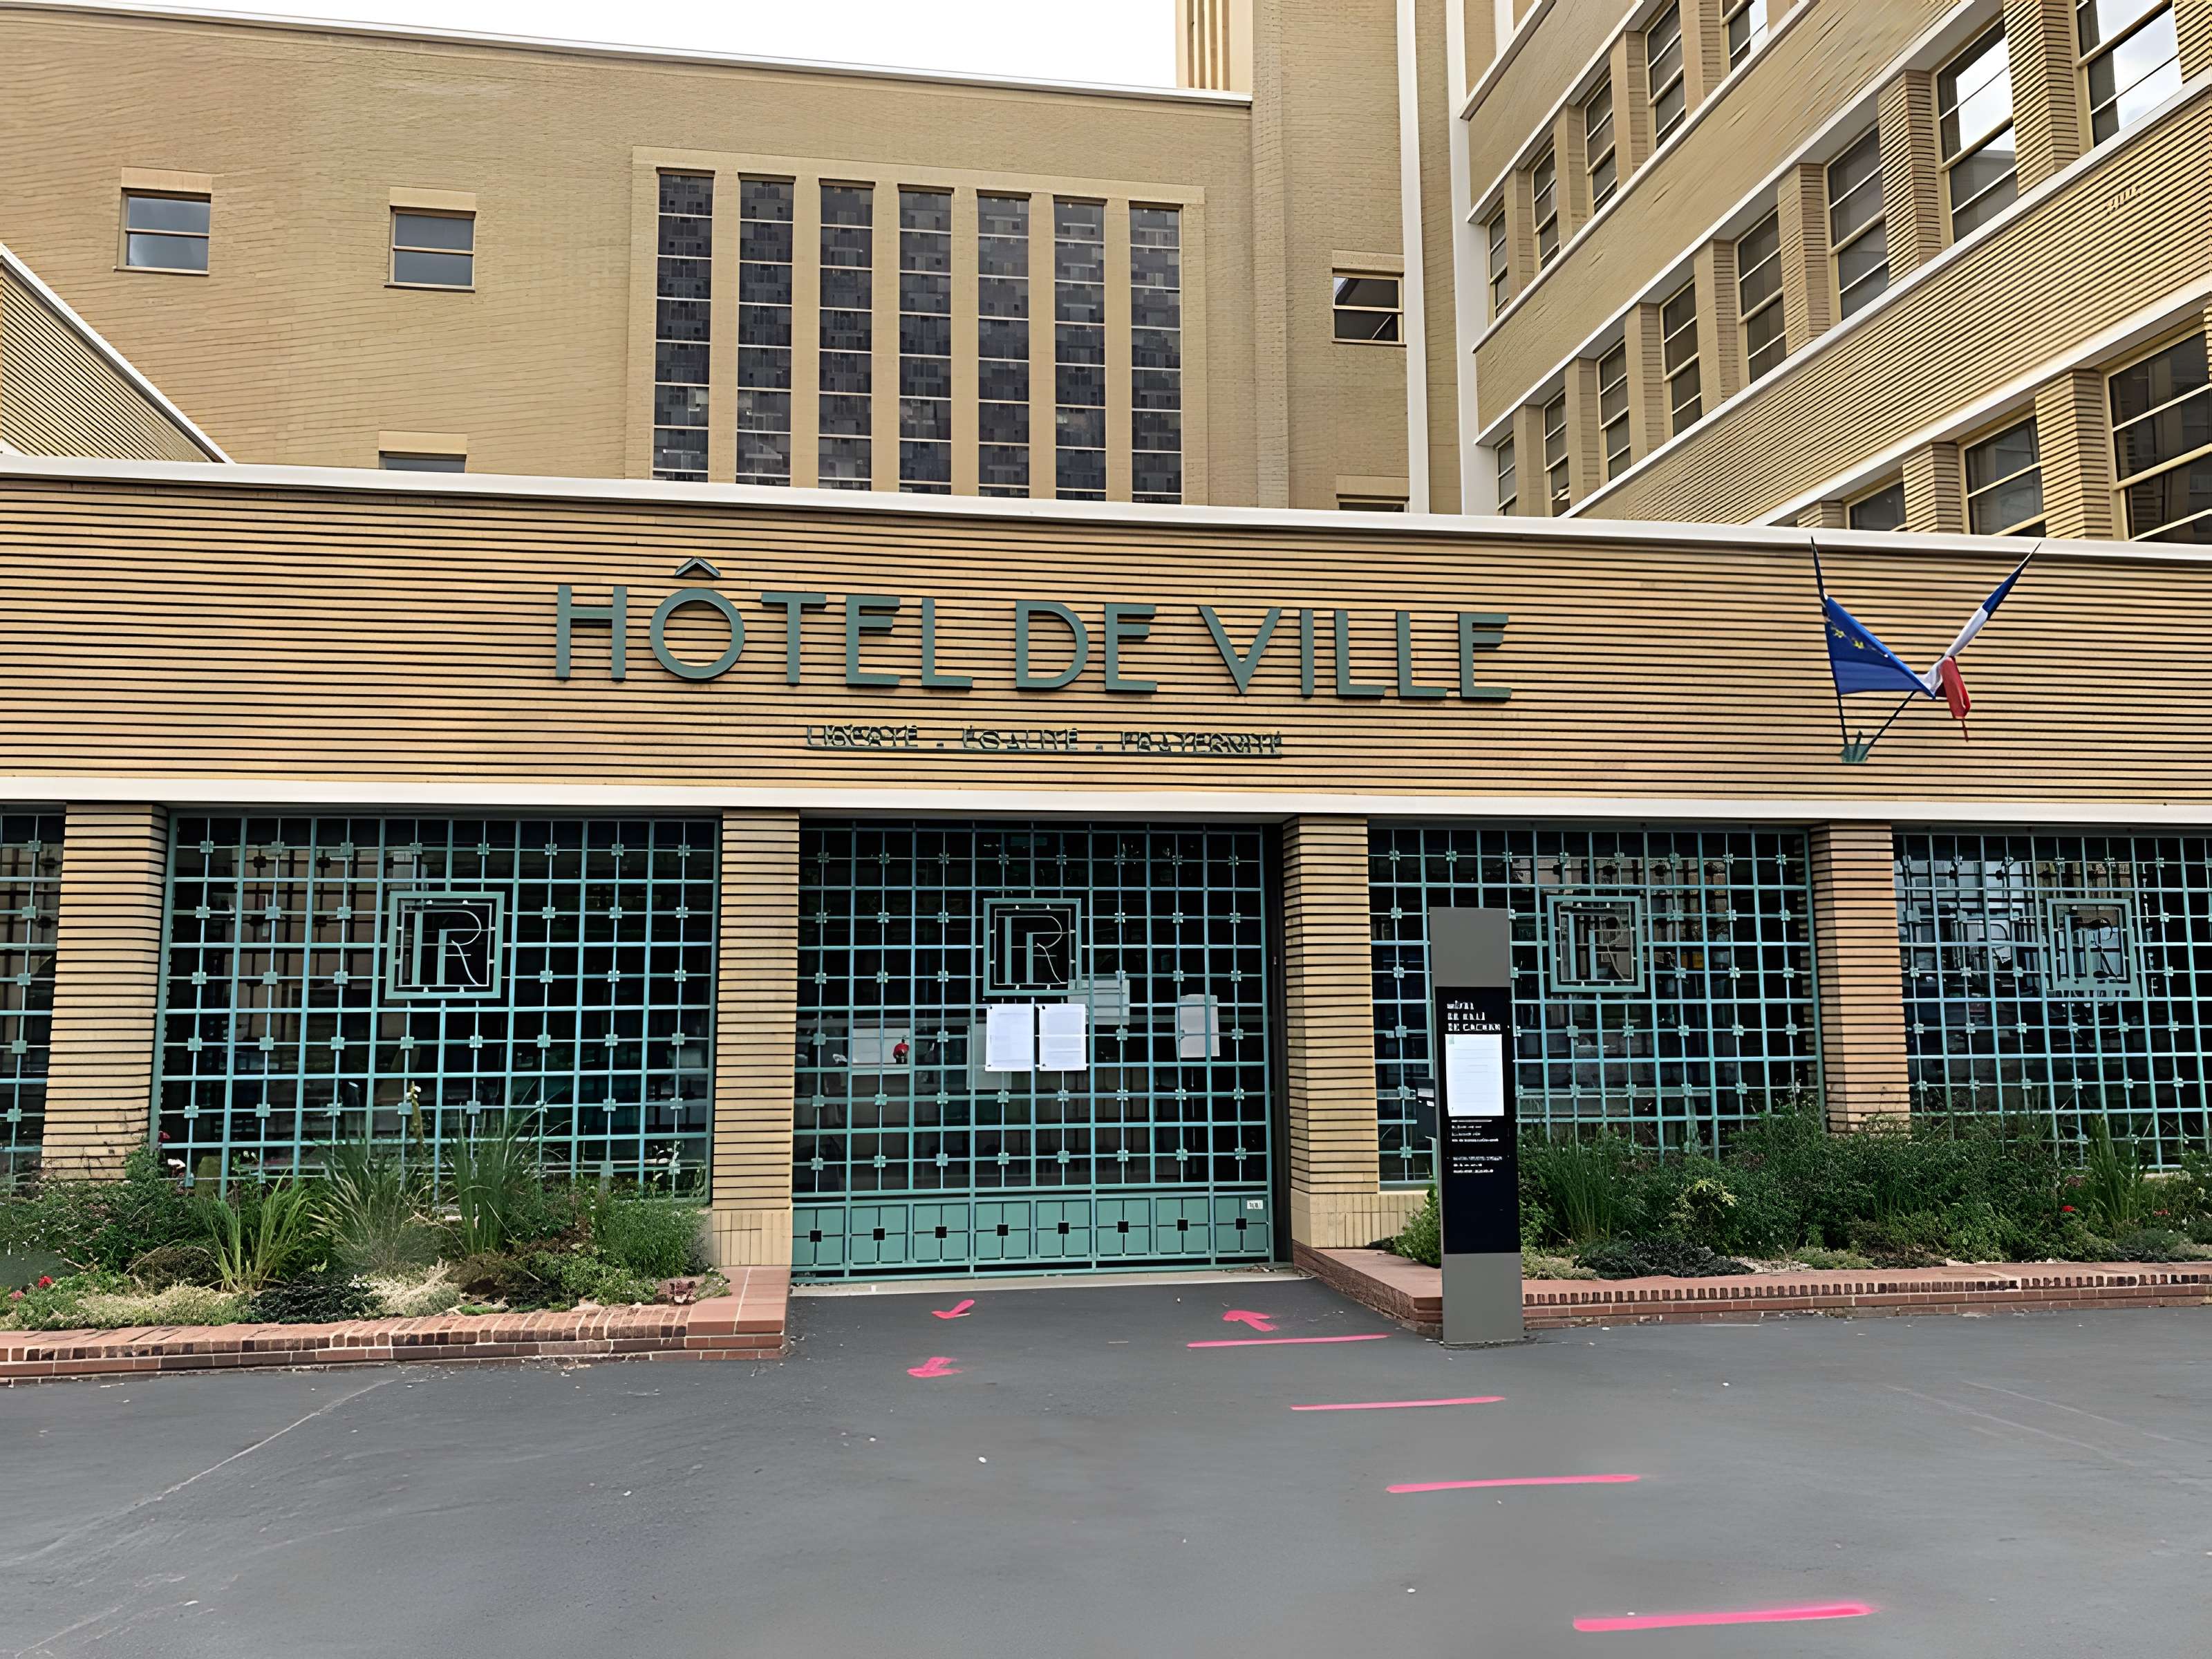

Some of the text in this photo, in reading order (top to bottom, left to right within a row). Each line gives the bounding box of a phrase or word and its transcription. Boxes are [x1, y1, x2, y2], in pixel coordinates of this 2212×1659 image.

[555, 557, 1512, 700] HÔTEL DE VILLE
